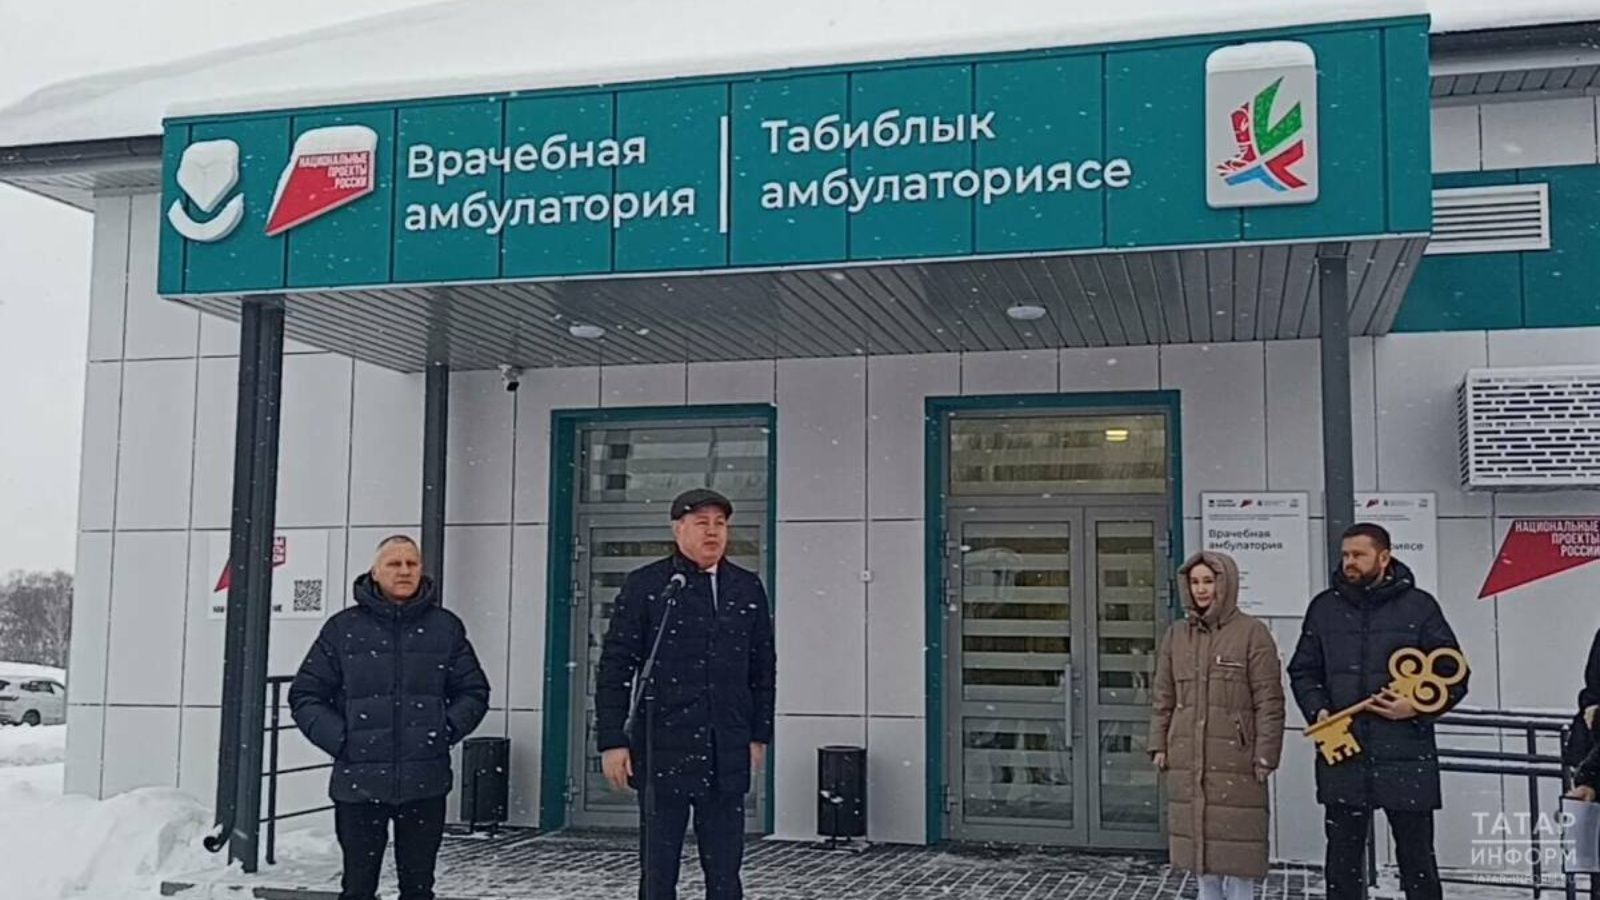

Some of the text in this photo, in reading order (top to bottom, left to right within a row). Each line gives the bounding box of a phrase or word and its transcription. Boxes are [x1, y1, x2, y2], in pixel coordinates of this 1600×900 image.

[760, 109, 997, 154] Табиблык
[406, 134, 647, 185] Врачебная
[327, 165, 368, 177] ПРОЕКТЫ
[335, 176, 367, 189] РОССИИ
[760, 156, 1133, 213] амбулаториясе
[404, 186, 696, 235] амбулатория
[1515, 520, 1599, 533] НАЦИОНАЛЬНЫЕ
[1208, 529, 1271, 539] Врачебная
[1551, 532, 1600, 545] ПРОЕКТЫ
[1208, 541, 1283, 552] амбулатория
